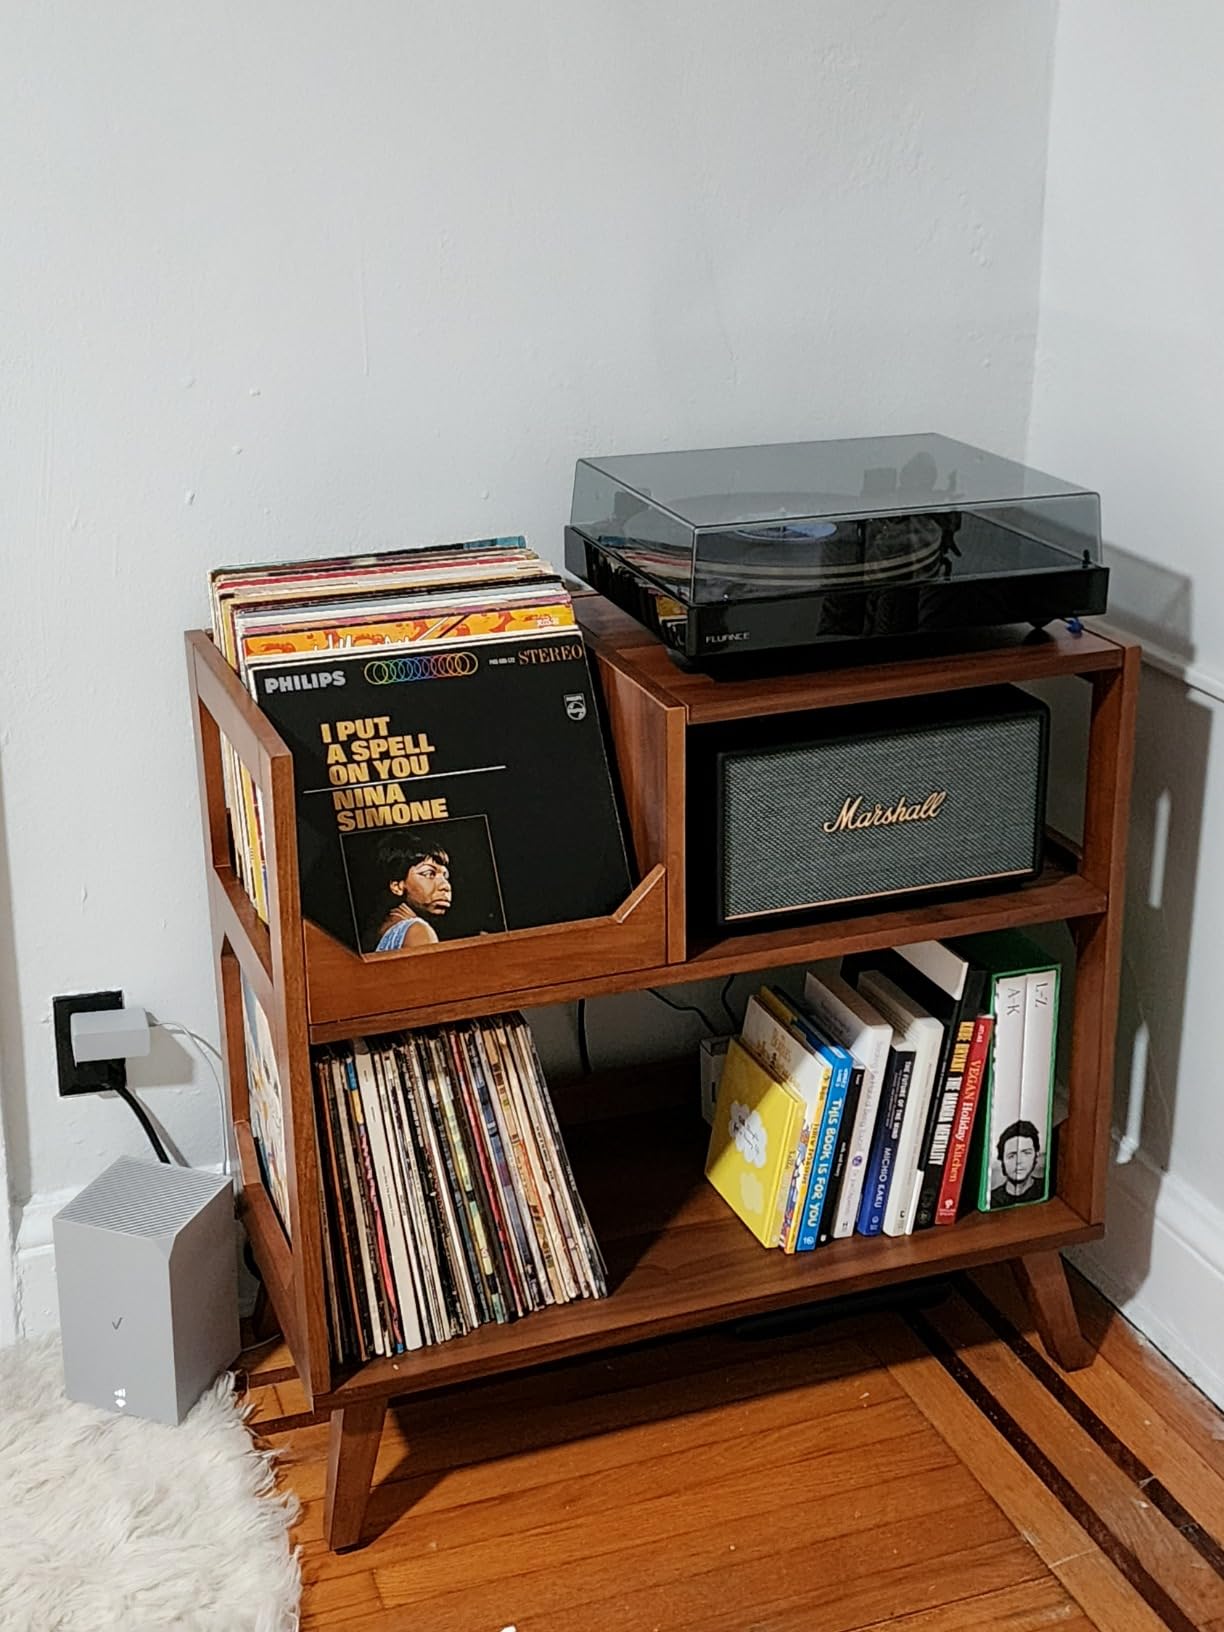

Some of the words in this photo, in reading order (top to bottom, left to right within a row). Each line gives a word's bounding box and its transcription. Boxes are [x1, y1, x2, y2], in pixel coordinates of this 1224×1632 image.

[518, 644, 583, 665] STEREO
[264, 671, 346, 694] PHILIPS
[321, 723, 332, 743] I
[336, 716, 390, 741] PUT
[327, 744, 348, 764] A
[351, 733, 436, 762] SPELL
[329, 762, 370, 786] ON
[373, 755, 430, 780] YOU
[332, 783, 406, 811] NINA
[823, 791, 947, 832] Marshall
[337, 798, 449, 832] SIMONE
[964, 1060, 981, 1100] VEGAN
[828, 1098, 842, 1124] THIS
[955, 1102, 973, 1141] Holiday
[820, 1127, 837, 1160] BOOK
[817, 1163, 829, 1175] IS
[879, 1147, 892, 1182] MICHIO
[949, 1143, 965, 1182] Kitchen
[811, 1177, 826, 1200] FOR
[874, 1184, 885, 1208] KAKU
[807, 1202, 820, 1227] YOU
